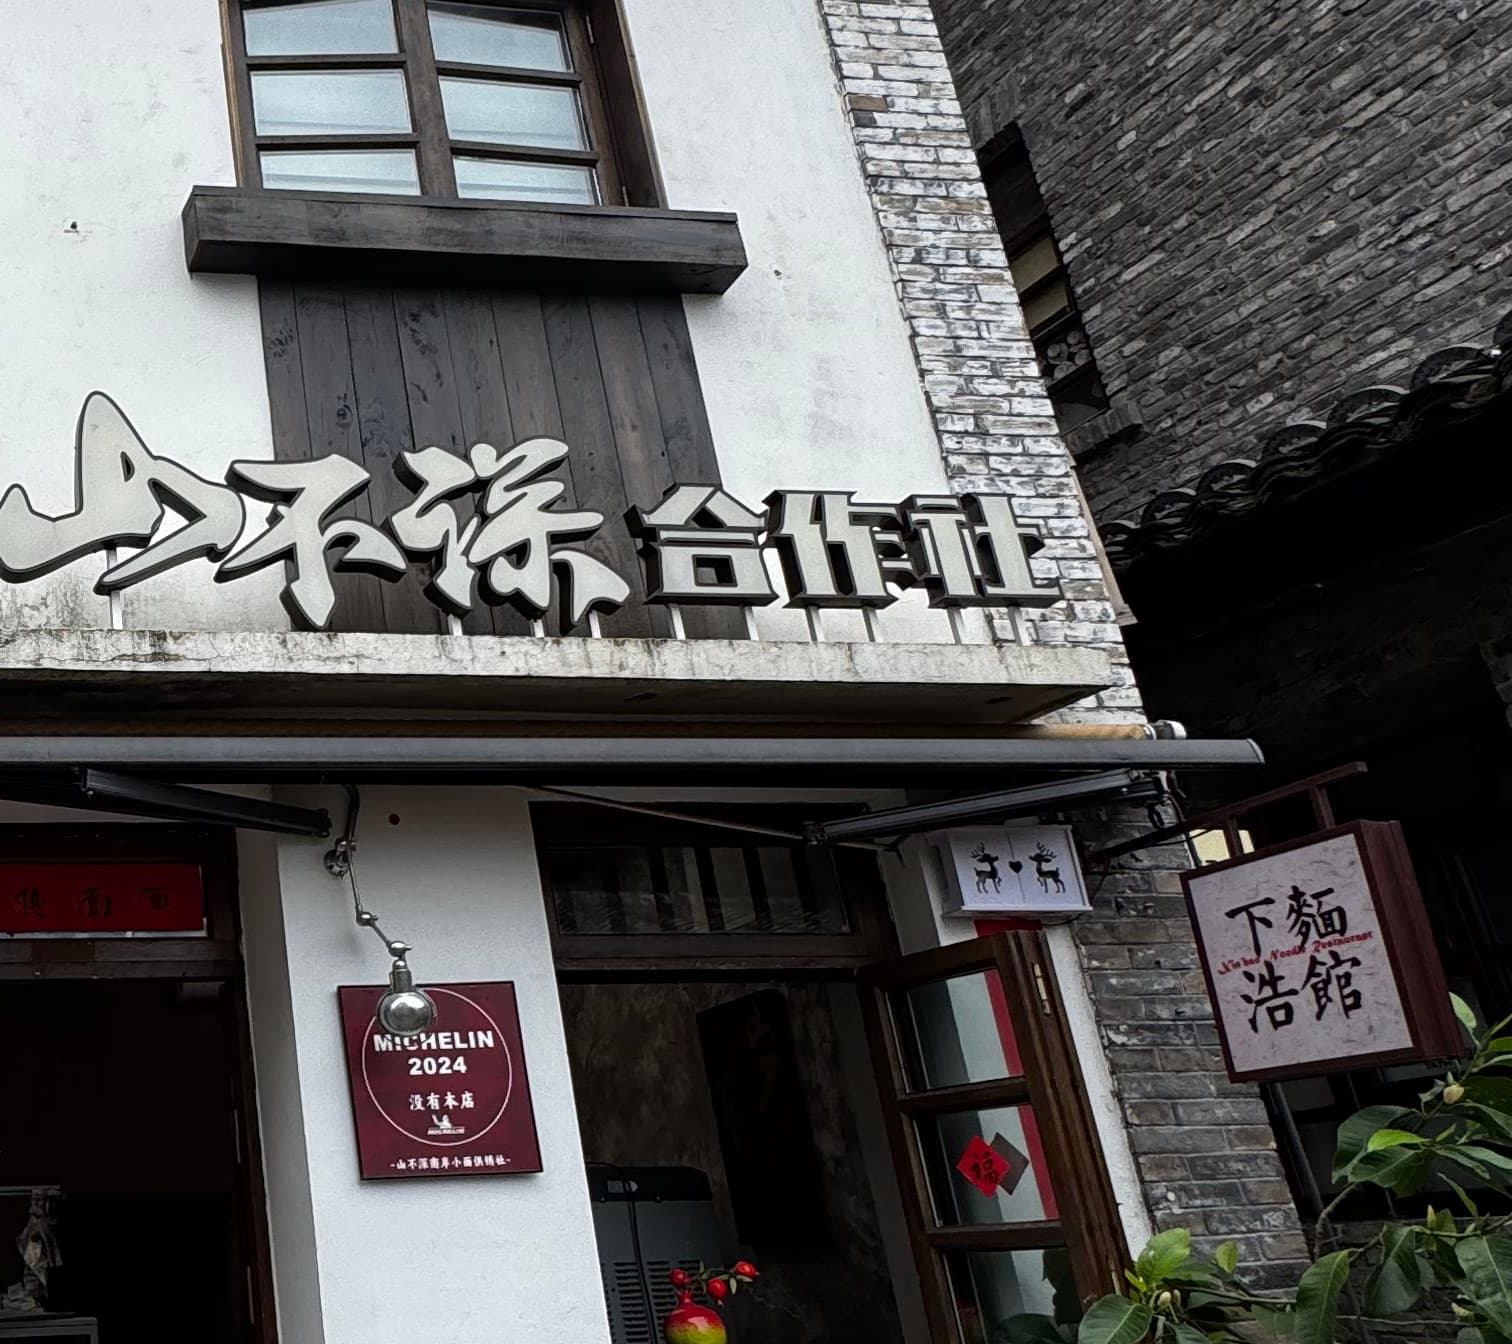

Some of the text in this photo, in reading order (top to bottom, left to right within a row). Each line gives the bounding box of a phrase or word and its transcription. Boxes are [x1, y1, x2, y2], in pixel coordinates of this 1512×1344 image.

[628, 484, 1063, 610] 合作社
[373, 1029, 496, 1053] MICHELIN
[407, 1055, 468, 1077] 2024
[408, 1090, 476, 1112] 没有本店
[970, 1151, 1001, 1185] 福
